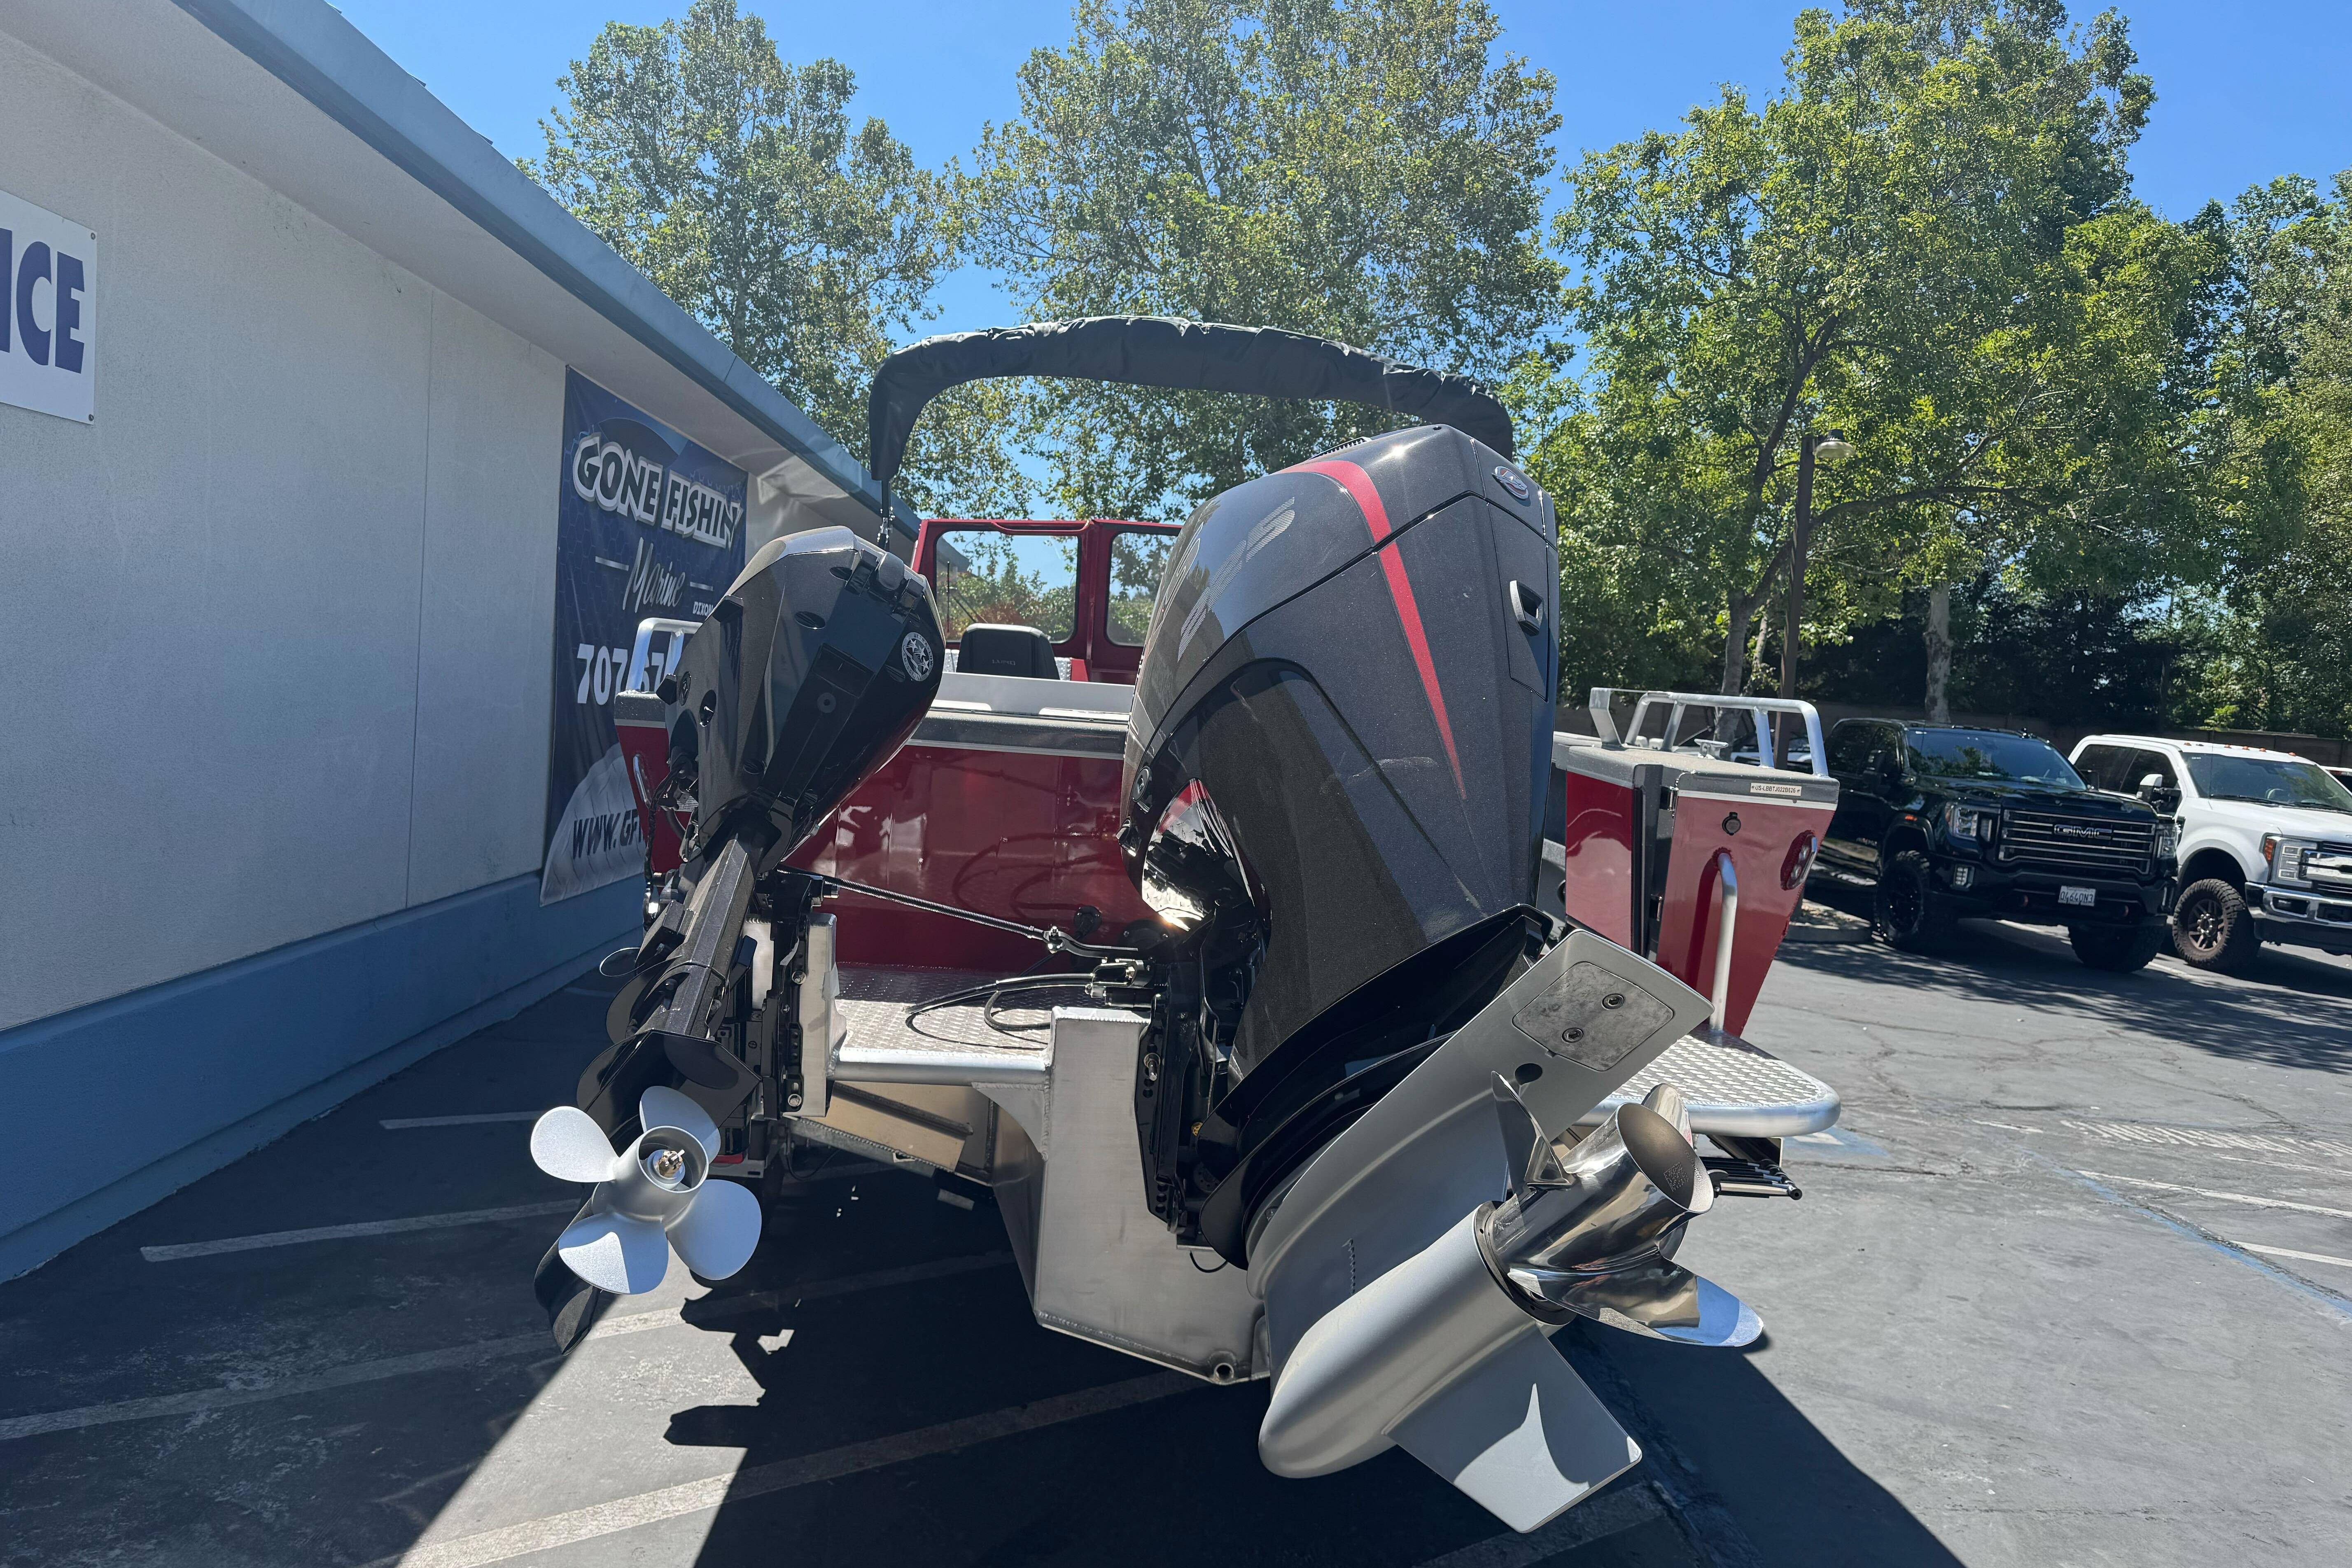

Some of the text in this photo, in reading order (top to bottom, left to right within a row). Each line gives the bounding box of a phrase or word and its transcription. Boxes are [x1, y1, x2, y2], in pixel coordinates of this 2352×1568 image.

[575, 436, 661, 522] GONE
[622, 537, 686, 613] Marine
[2054, 824, 2112, 840] GMC
